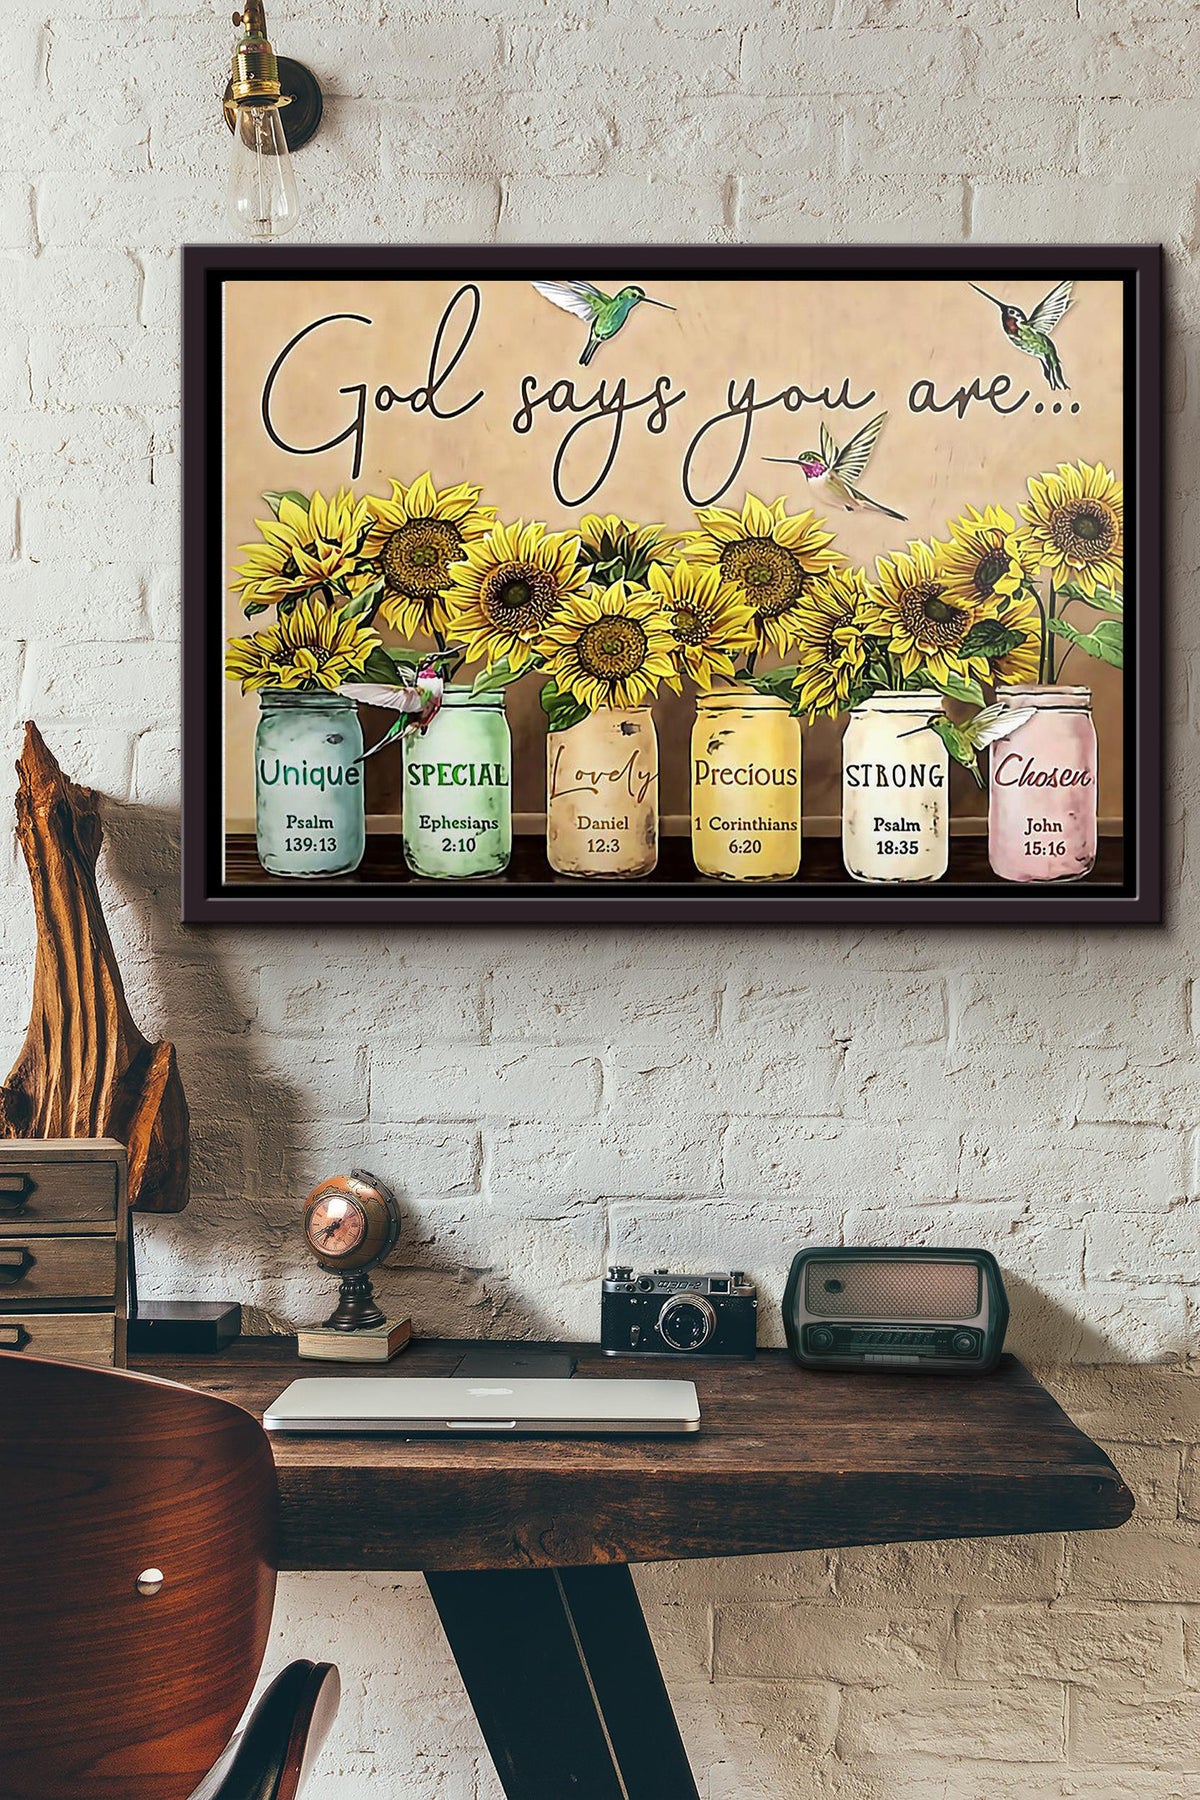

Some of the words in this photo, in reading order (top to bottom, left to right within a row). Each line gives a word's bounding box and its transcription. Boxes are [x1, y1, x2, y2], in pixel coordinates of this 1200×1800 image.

[261, 283, 484, 480] God
[512, 374, 686, 507] says
[682, 376, 876, 507] you
[908, 373, 1081, 420] are...
[260, 759, 360, 791] Unique
[407, 763, 509, 787] SPECIAL
[549, 745, 660, 804] Lovely
[694, 759, 798, 786] Precious
[846, 763, 945, 788] STRONG
[994, 752, 1093, 788] Chosen
[285, 814, 334, 830] Psalm
[419, 814, 499, 833] Ephesians
[577, 815, 629, 830] Daniel
[695, 817, 702, 831] 1
[709, 816, 798, 832] Corinthians
[873, 817, 921, 833] Psalm
[1024, 817, 1063, 836] John
[285, 837, 337, 852] 139:13
[441, 838, 476, 853] 2:10
[587, 838, 620, 853] 12:3
[728, 839, 762, 854] 6:20
[876, 840, 919, 855] 18:35
[1024, 840, 1066, 856] 15:16
